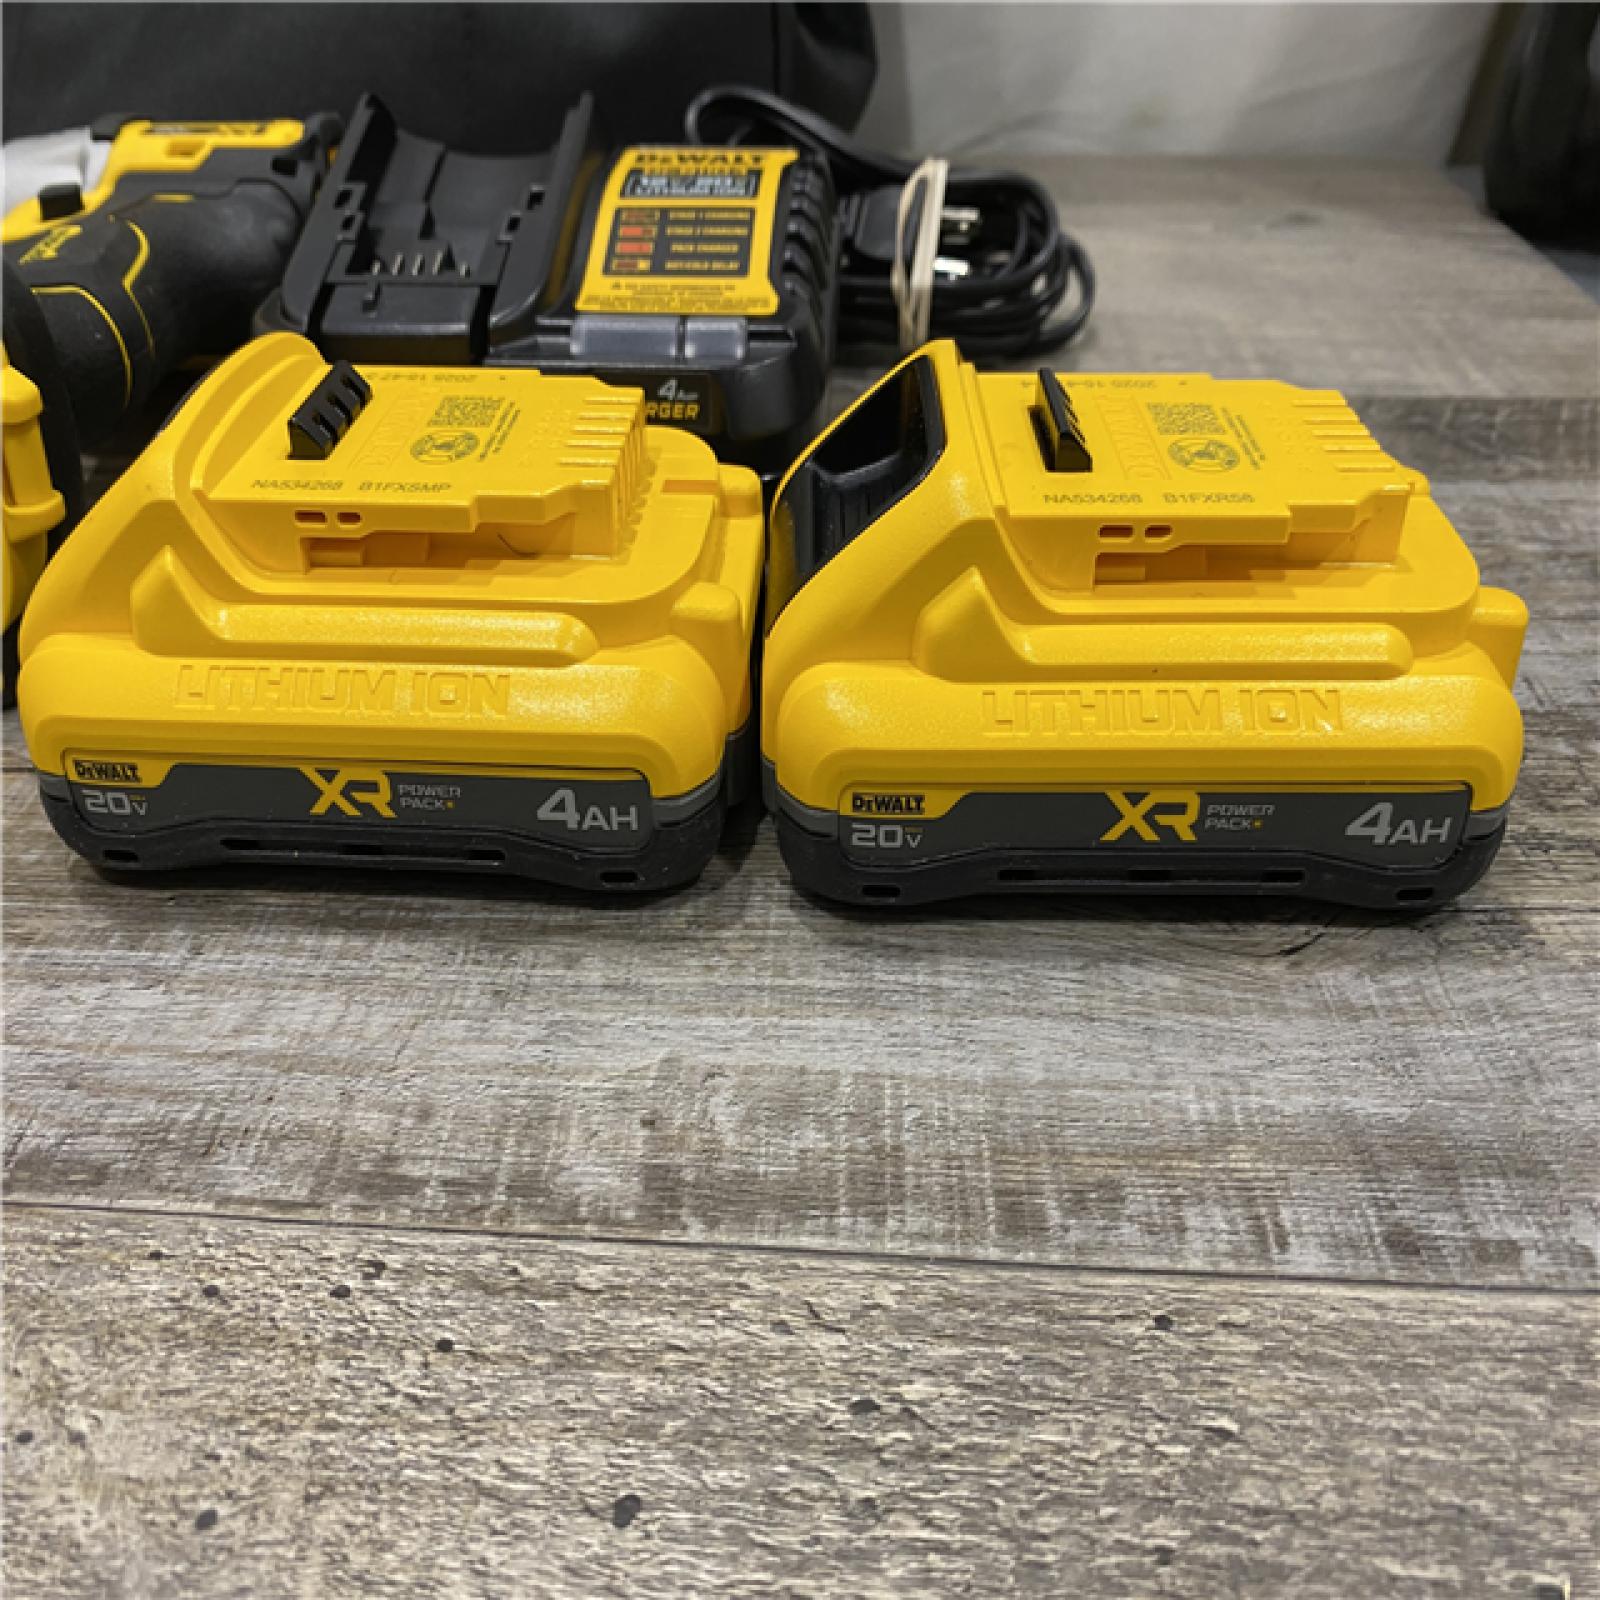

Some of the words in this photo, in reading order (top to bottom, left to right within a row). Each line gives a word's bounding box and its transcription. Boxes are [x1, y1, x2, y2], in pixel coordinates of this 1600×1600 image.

[645, 402, 699, 420] RGER
[174, 664, 396, 715] LITHIUM
[410, 670, 510, 719] ION
[981, 689, 1223, 736] LITHIUM
[1238, 689, 1343, 736] ION
[299, 768, 398, 819] XR
[1100, 790, 1199, 841] XR
